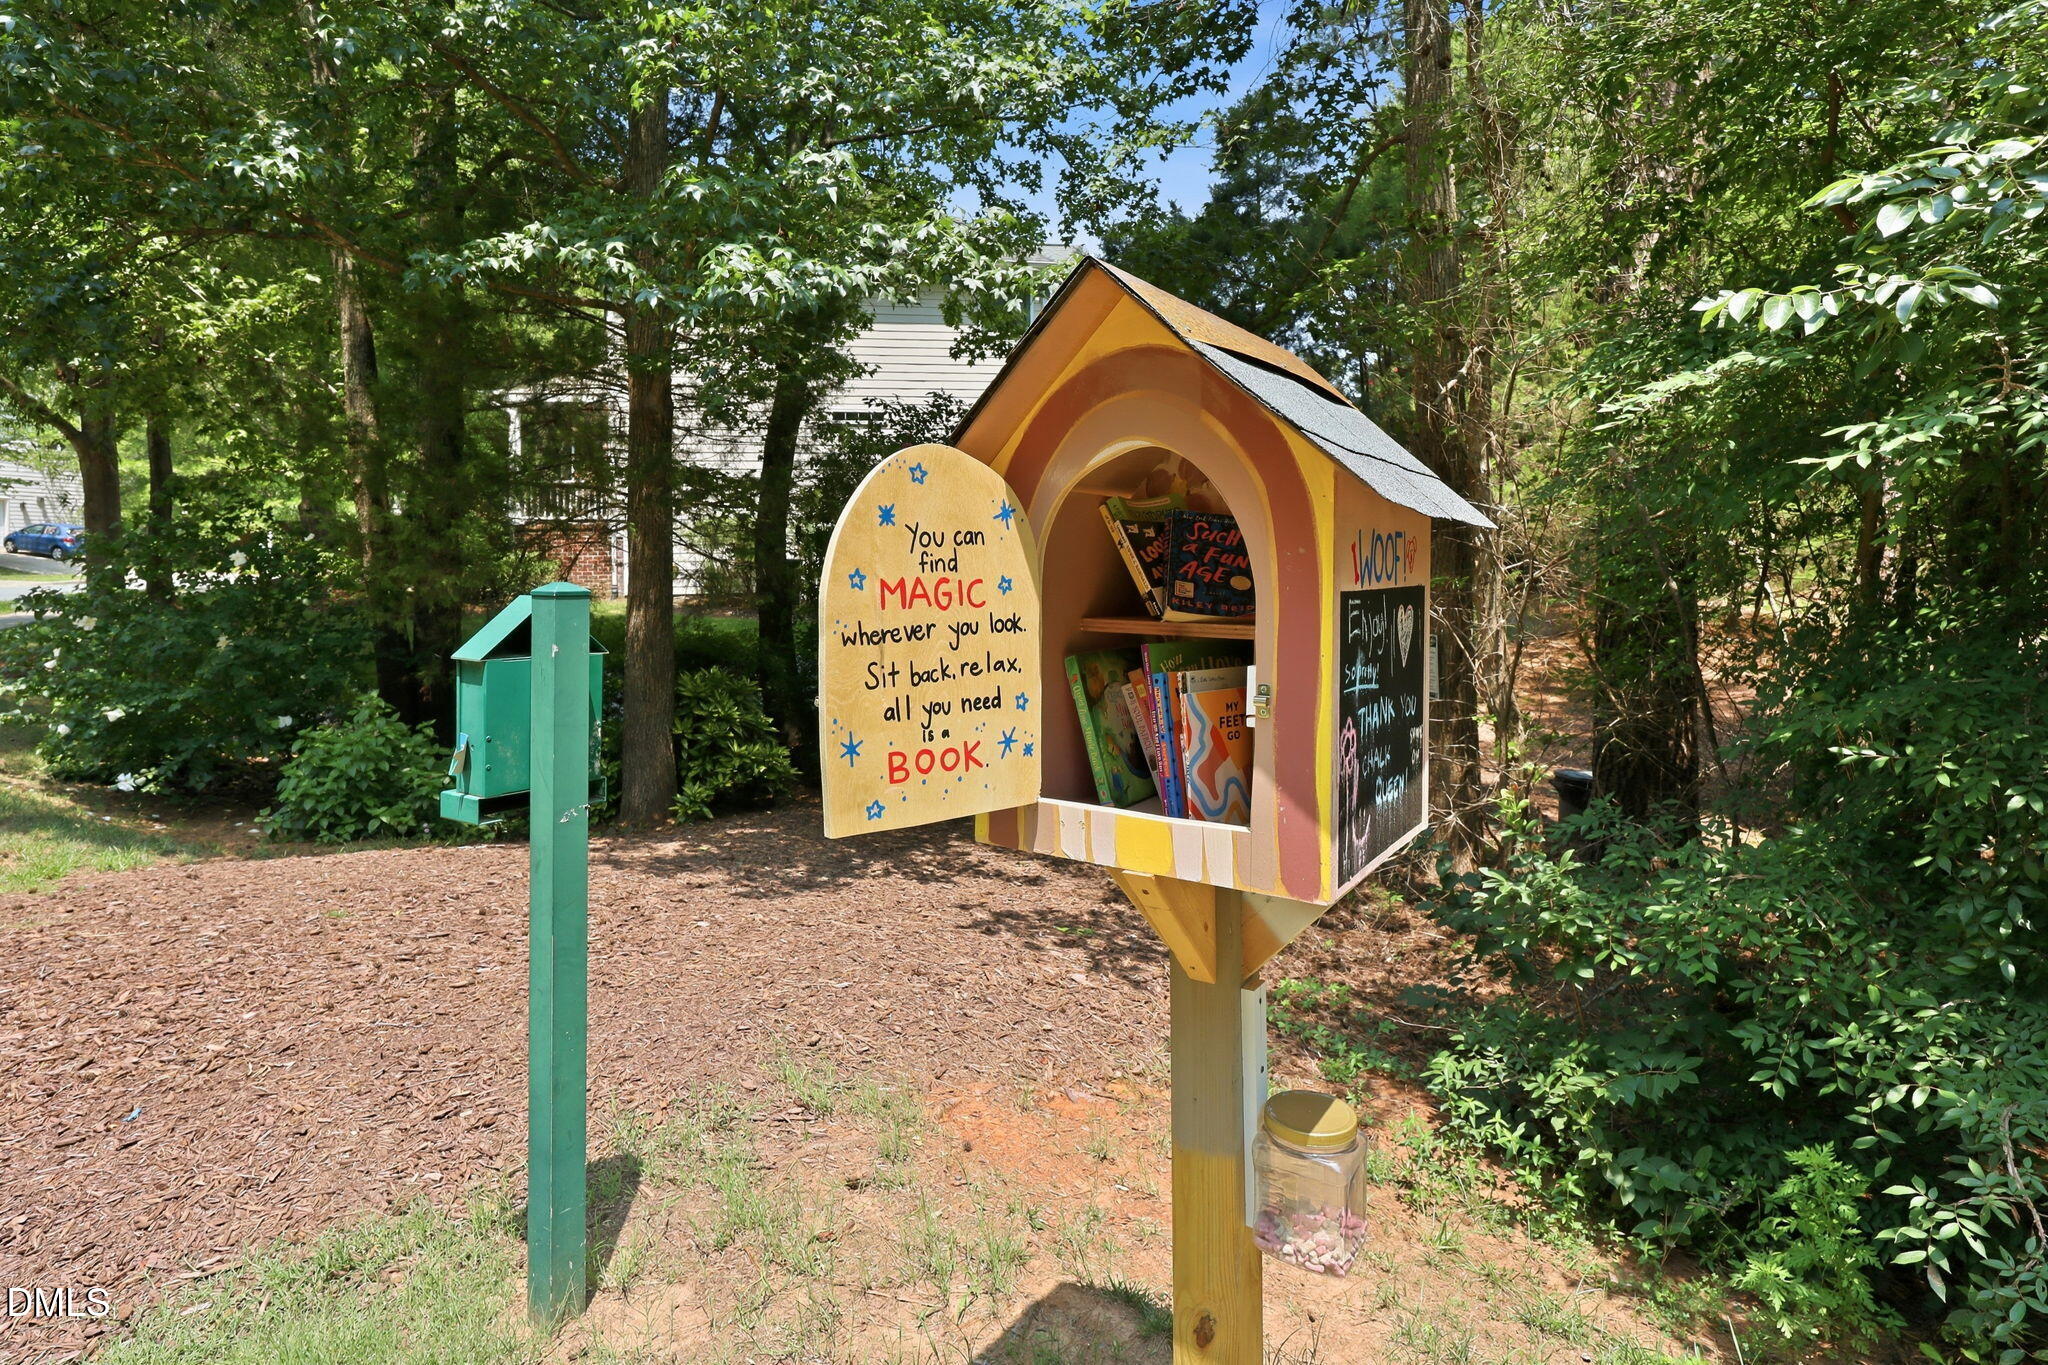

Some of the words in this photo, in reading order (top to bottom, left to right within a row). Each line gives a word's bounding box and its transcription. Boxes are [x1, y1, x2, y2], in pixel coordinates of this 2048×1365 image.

[904, 522, 945, 552] You
[953, 530, 985, 547] can
[918, 548, 959, 574] find
[1179, 560, 1231, 583] AGE
[1358, 527, 1407, 589] WOOF!
[879, 576, 986, 612] MAGIC
[841, 620, 937, 648] wherever
[947, 621, 980, 651] you
[989, 611, 1027, 635] look.
[864, 661, 900, 691] Sit
[910, 656, 956, 688] back,
[960, 651, 1022, 677] relax,
[883, 694, 911, 723] all
[921, 700, 951, 728] you
[960, 685, 1002, 712] need
[1219, 713, 1245, 729] FEET
[1225, 700, 1239, 712] MY
[1357, 696, 1396, 735] THANK
[1400, 692, 1417, 718] YOU
[922, 727, 935, 744] is
[941, 729, 950, 740] a
[1227, 730, 1241, 741] GO
[887, 739, 989, 786] BOOK.
[1362, 744, 1391, 778] CHALK
